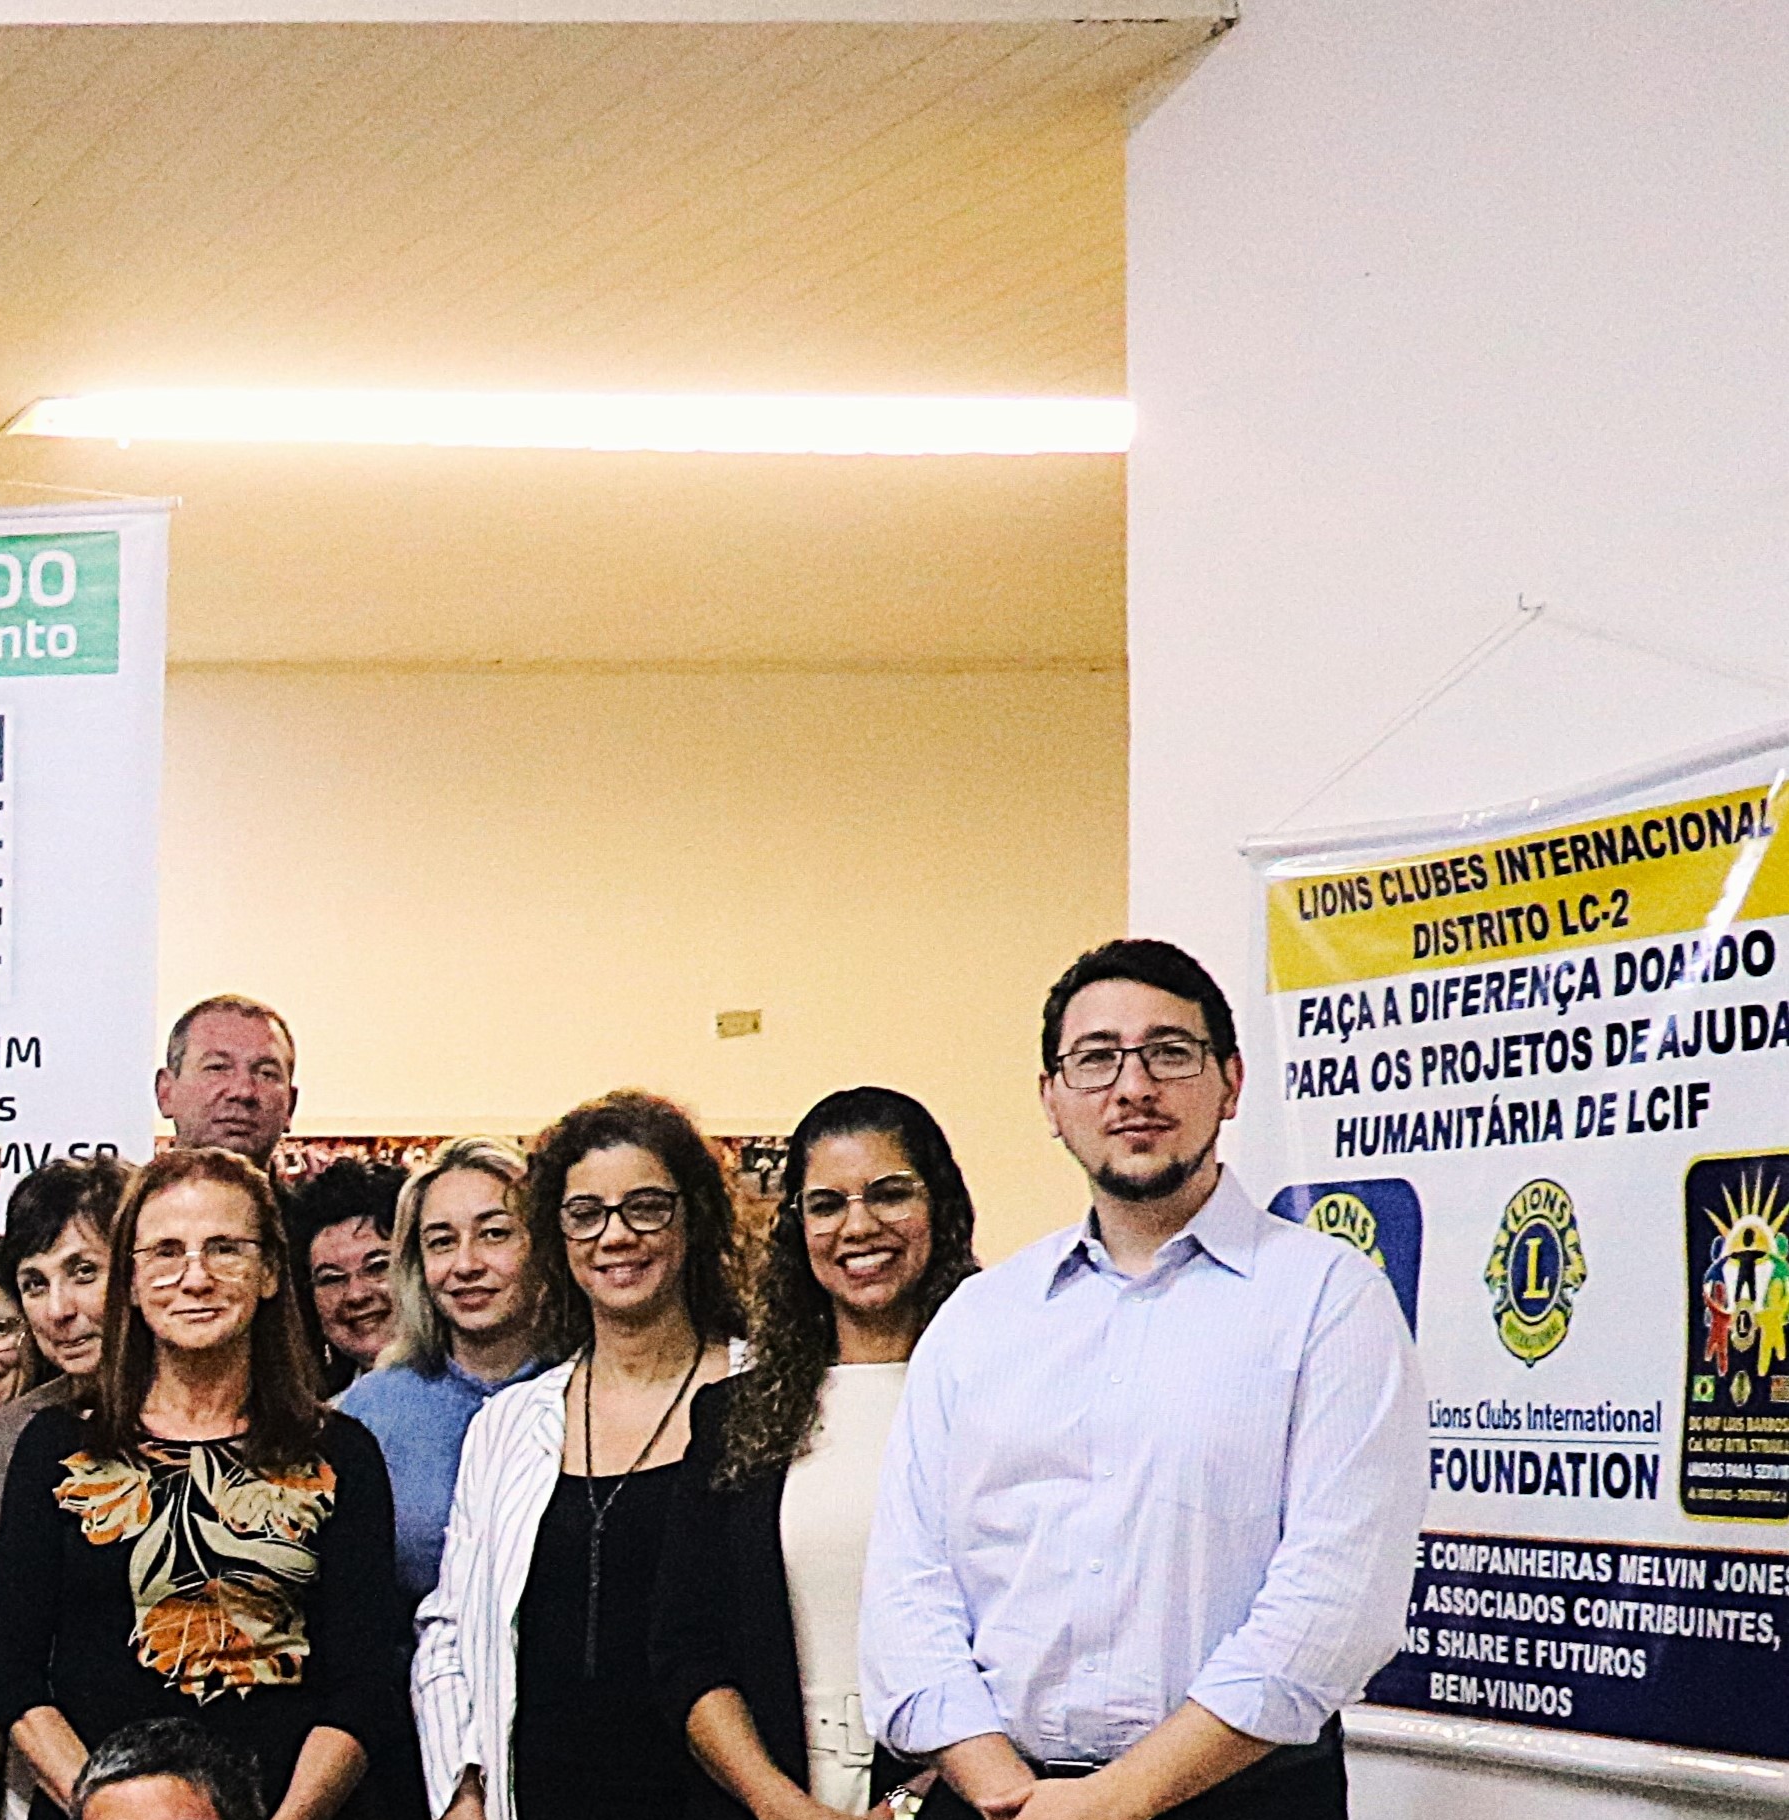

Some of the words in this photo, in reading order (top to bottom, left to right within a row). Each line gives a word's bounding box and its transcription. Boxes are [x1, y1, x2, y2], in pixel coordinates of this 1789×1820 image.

[1298, 876, 1373, 921] LIONS
[1380, 853, 1488, 903] CLUBES
[1495, 797, 1775, 884] INTERNACIONAL
[1413, 904, 1549, 959] DISTRITO
[1558, 888, 1630, 937] LC-2
[1298, 991, 1374, 1043] FAÇA
[1383, 987, 1402, 1027] A
[1411, 957, 1601, 1022] DIFERENÇA
[1286, 1055, 1360, 1100] PARA
[1371, 1050, 1412, 1091] OS
[1422, 1026, 1593, 1087] PROJETOS
[1606, 1018, 1651, 1067] DE
[1657, 999, 1789, 1062] AJUDA
[1336, 1094, 1563, 1158] HUMANITÁRIA
[1575, 1092, 1616, 1138] DE
[1626, 1082, 1710, 1134] LCIF
[1316, 1199, 1370, 1246] IONS
[1510, 1188, 1568, 1223] LIONS
[1523, 1237, 1550, 1299] L
[1429, 1399, 1471, 1428] Lions
[1477, 1399, 1522, 1430] Clubs
[1527, 1400, 1662, 1433] International
[1429, 1447, 1660, 1500] FOUNDATION
[1430, 1541, 1612, 1582] COMPANHEIRAS
[1618, 1554, 1707, 1590] MELVIN
[1423, 1584, 1566, 1625] ASSOCIADOS
[1573, 1597, 1781, 1651] CONTRIBUINTES,
[1435, 1628, 1509, 1665] SHARE
[1515, 1638, 1530, 1666] E
[1535, 1640, 1647, 1679] FUTUROS
[1429, 1671, 1574, 1718] BEM-VINDOS
